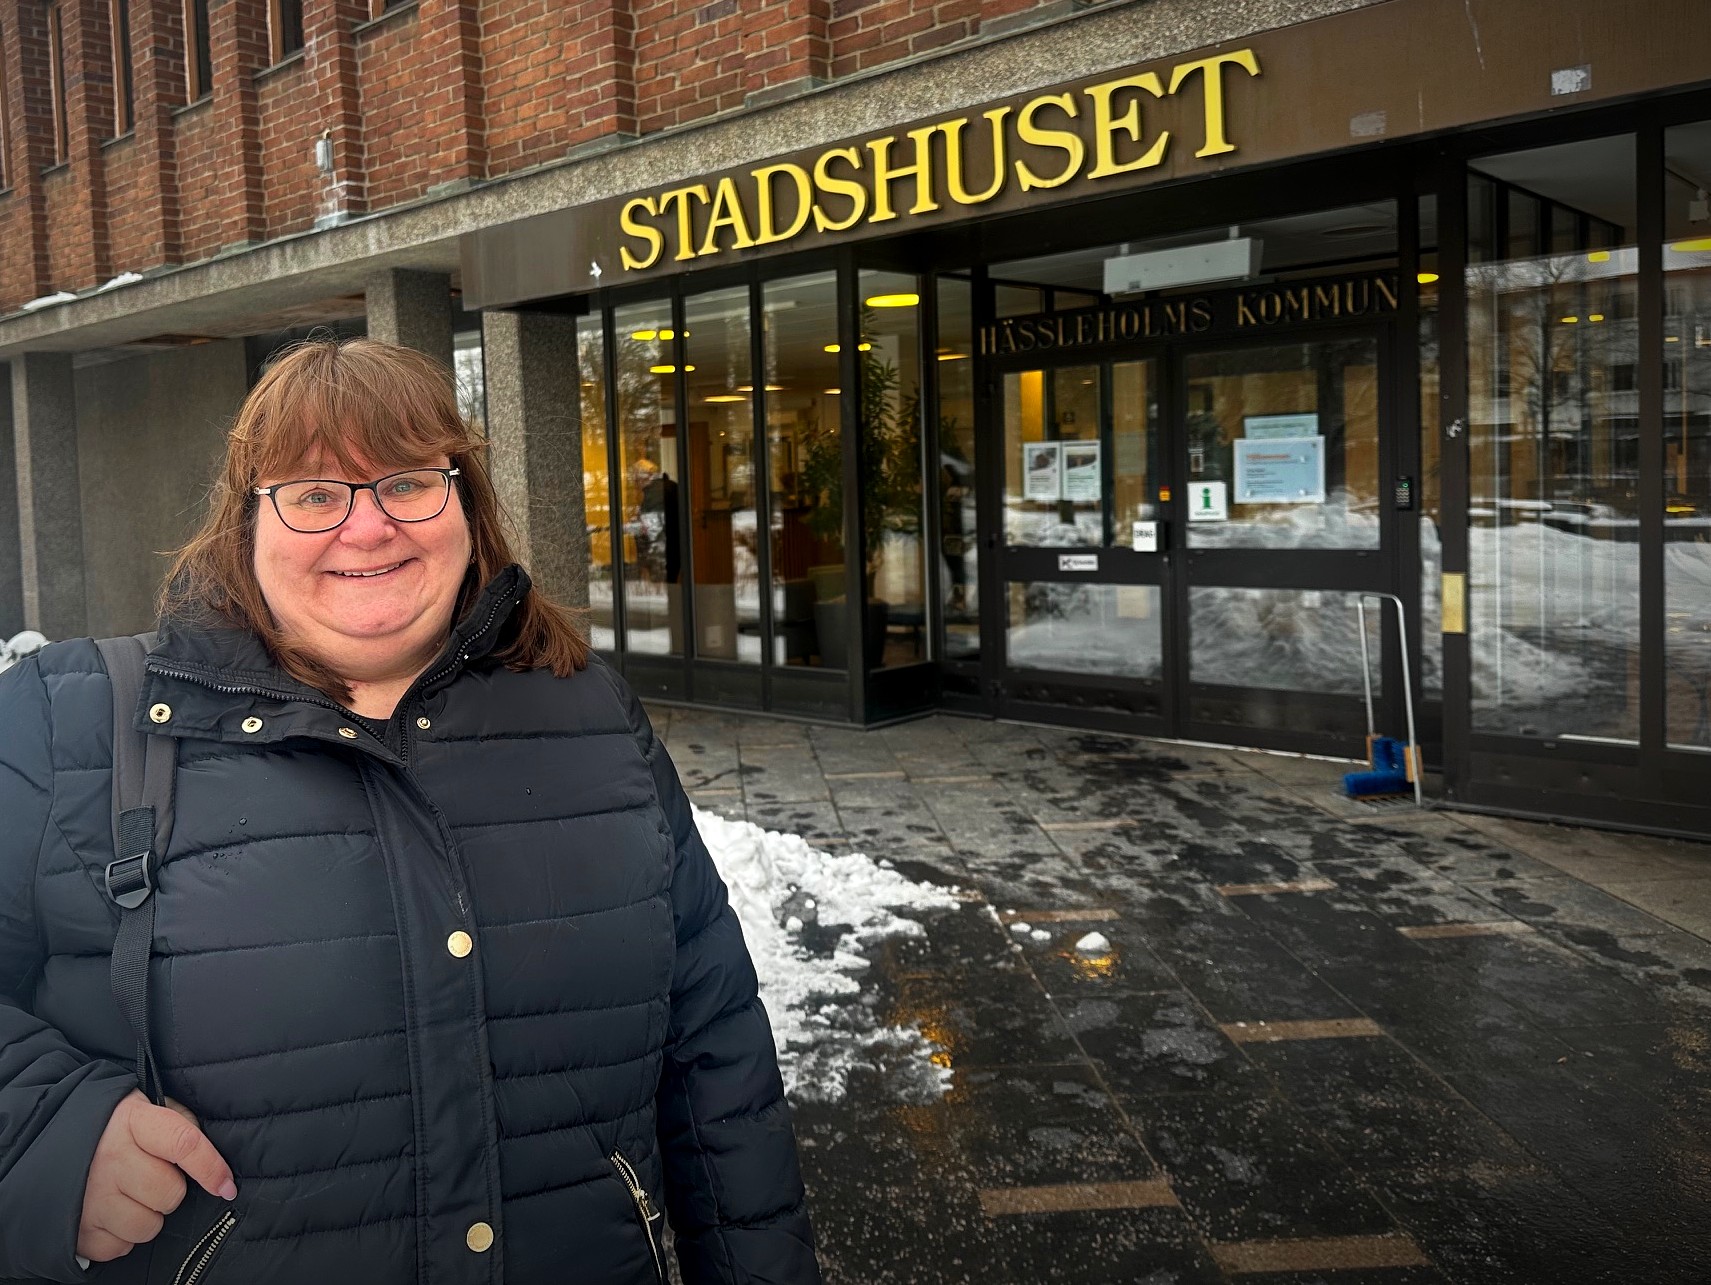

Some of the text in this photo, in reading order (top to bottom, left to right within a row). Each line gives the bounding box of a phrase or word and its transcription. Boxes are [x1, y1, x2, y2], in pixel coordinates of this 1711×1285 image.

[619, 48, 1262, 272] STADSHUSET
[979, 275, 1400, 356] HÄSSLEHOLMS KOMMUN
